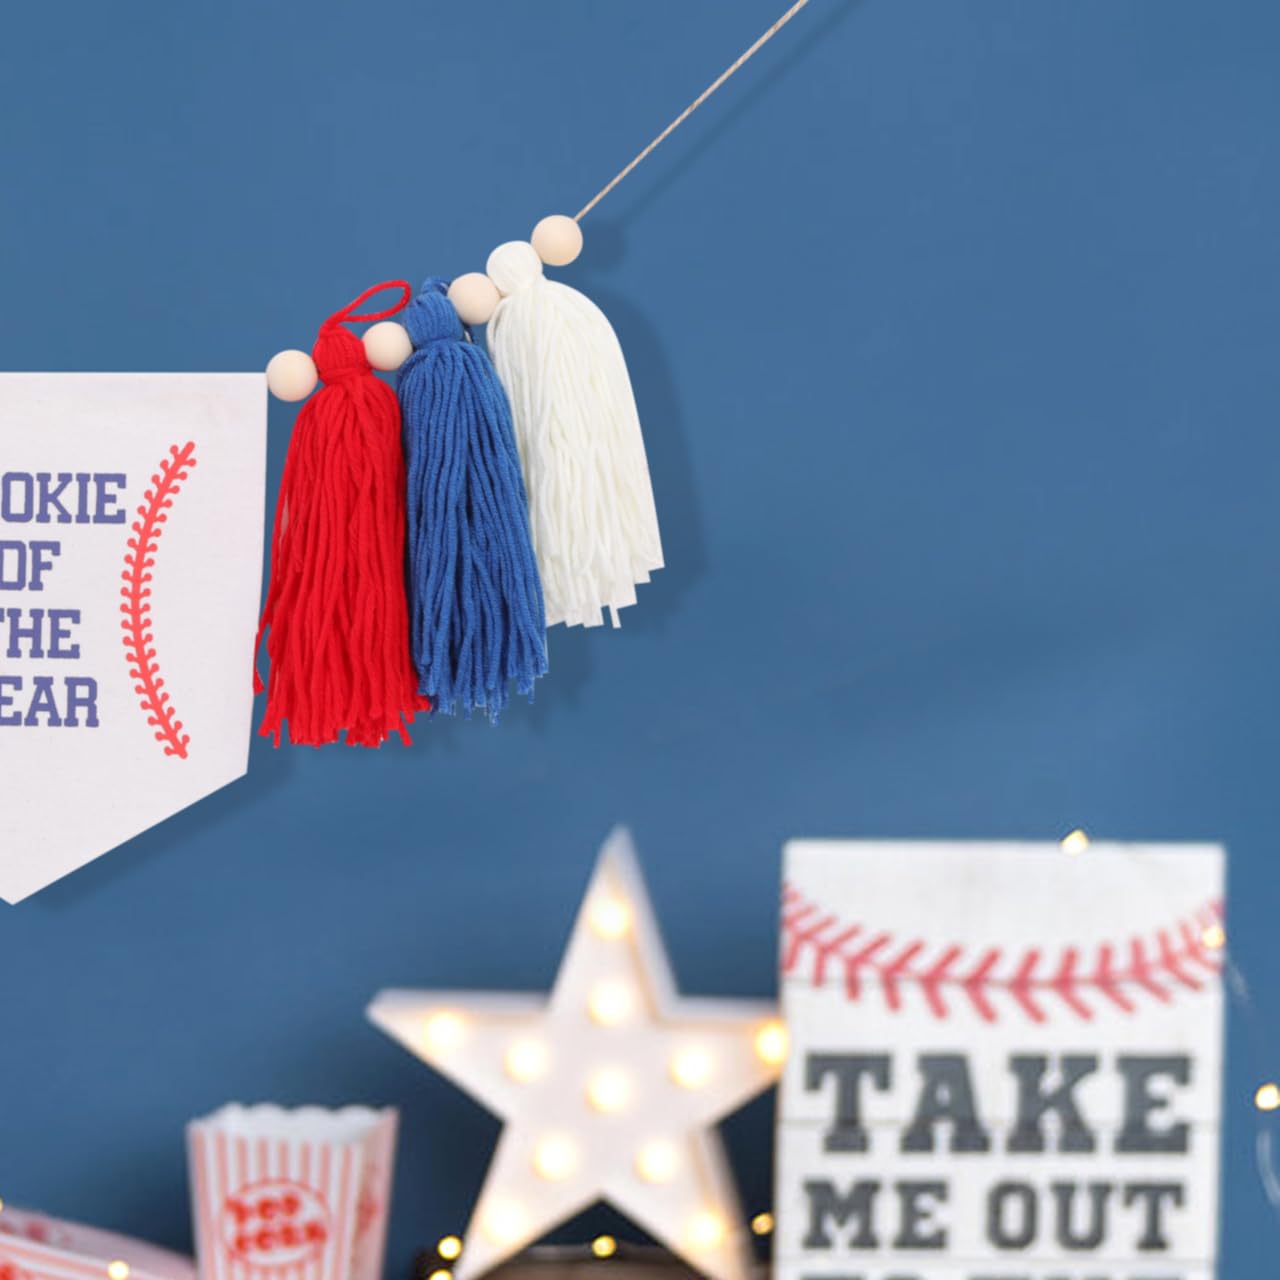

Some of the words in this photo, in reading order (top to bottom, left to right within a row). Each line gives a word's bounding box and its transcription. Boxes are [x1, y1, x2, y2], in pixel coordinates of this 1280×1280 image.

[803, 1052, 1193, 1155] TAKE
[800, 1179, 950, 1253] ME
[986, 1179, 1188, 1253] OUT
